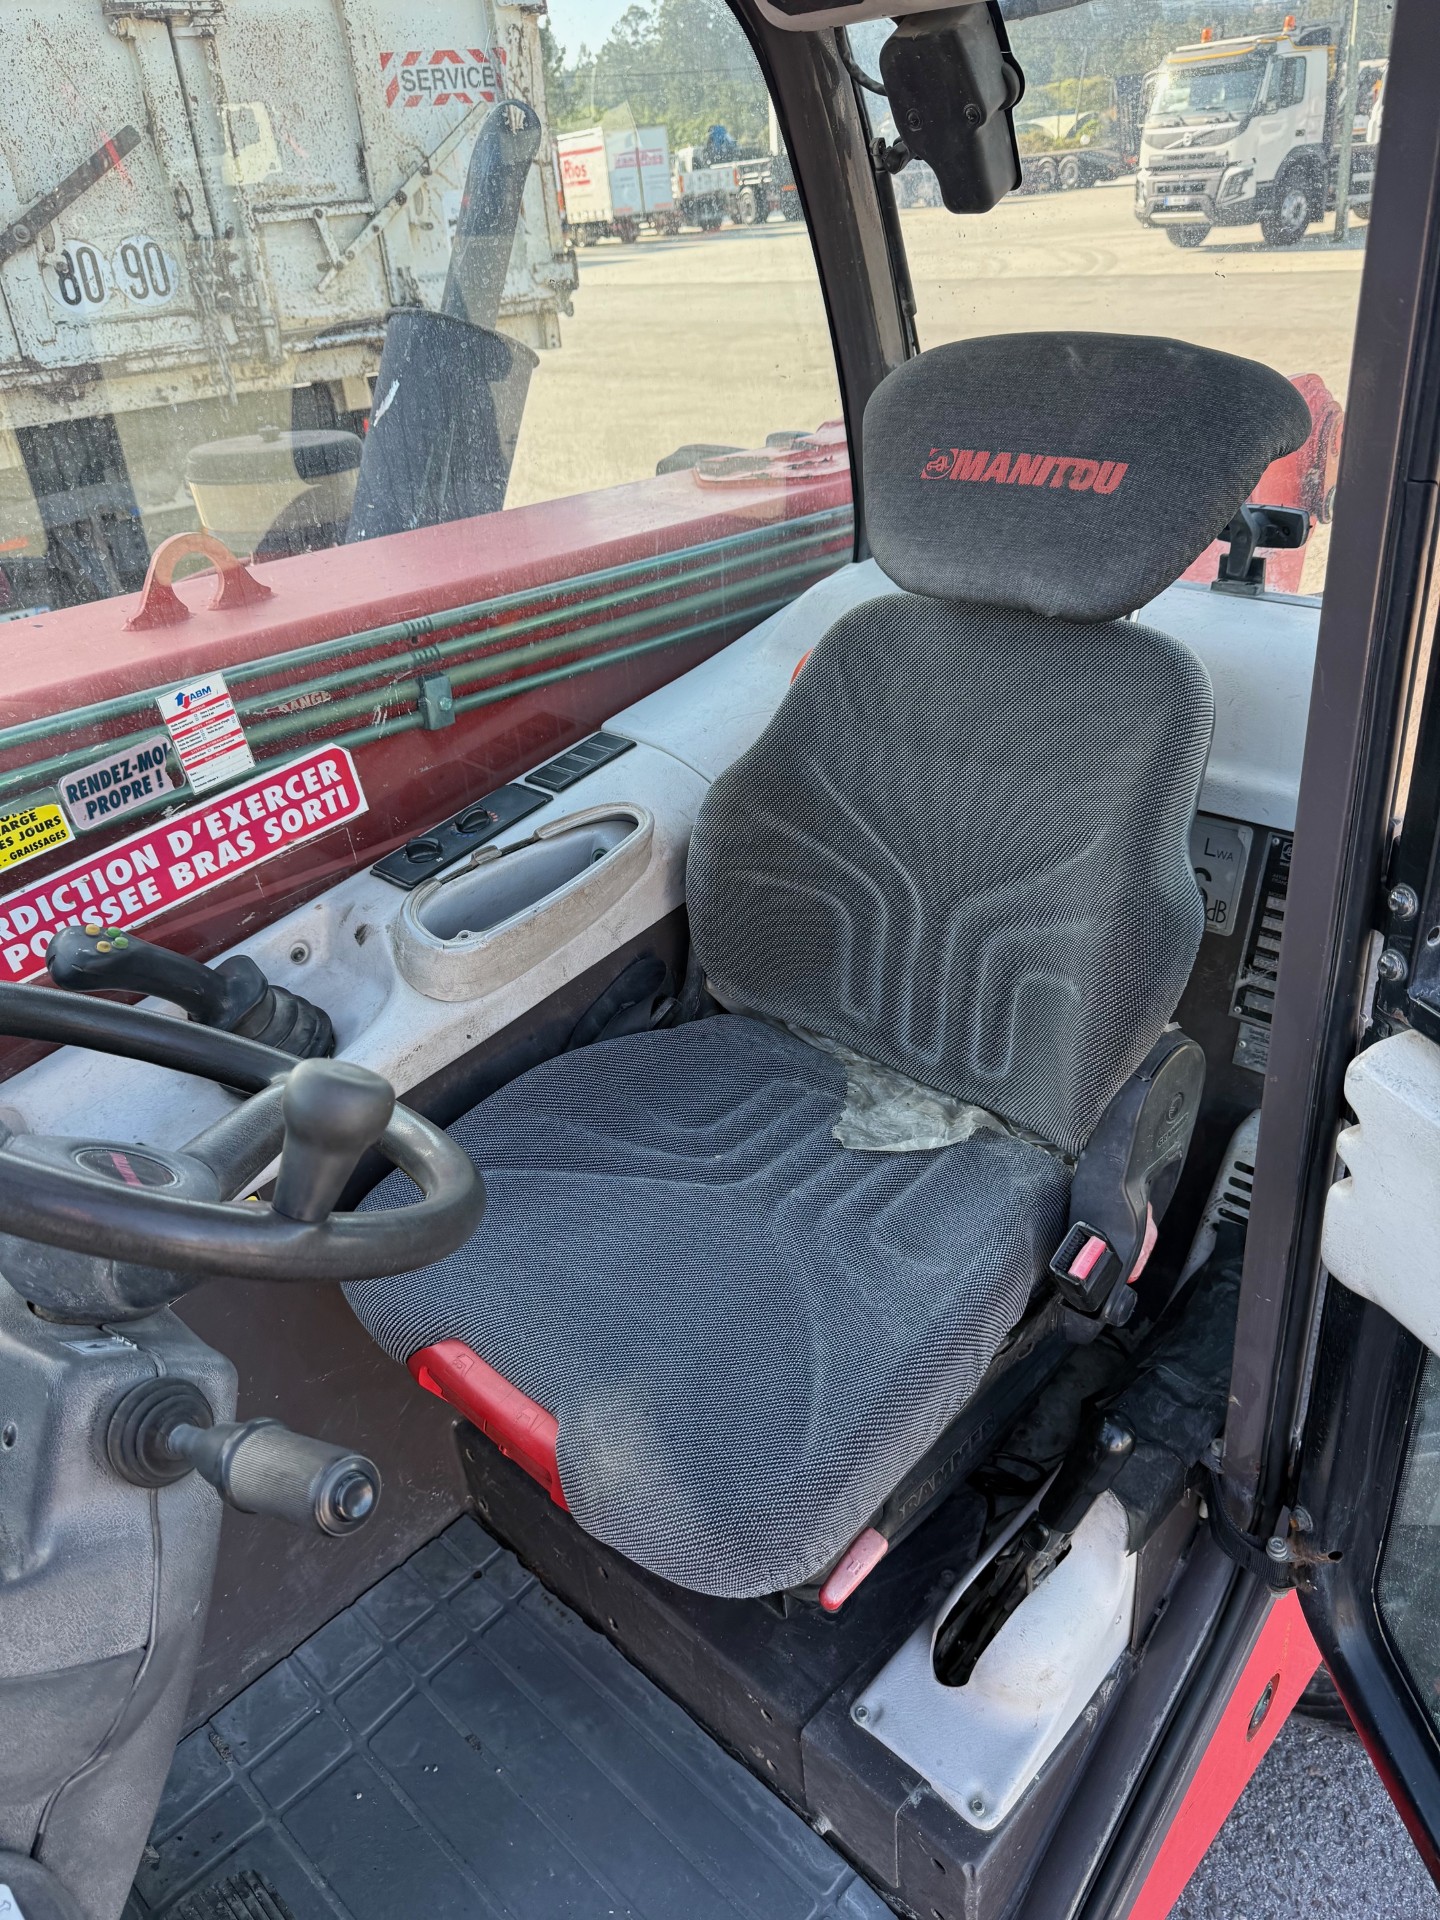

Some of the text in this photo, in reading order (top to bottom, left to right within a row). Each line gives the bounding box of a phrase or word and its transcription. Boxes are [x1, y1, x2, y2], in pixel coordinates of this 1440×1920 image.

[401, 66, 496, 92] SERVICE
[55, 246, 105, 306] 80
[120, 242, 171, 300] 90
[950, 449, 1130, 494] MANITOU
[190, 686, 212, 701] ABM
[85, 773, 153, 820] PROPRE
[166, 759, 342, 857] D'EXERCER
[9, 829, 67, 860] GRAISSAGES
[19, 815, 61, 841] JOURS
[2, 784, 351, 974] POSSEE BRAS SORTI
[1207, 899, 1228, 923] dB
